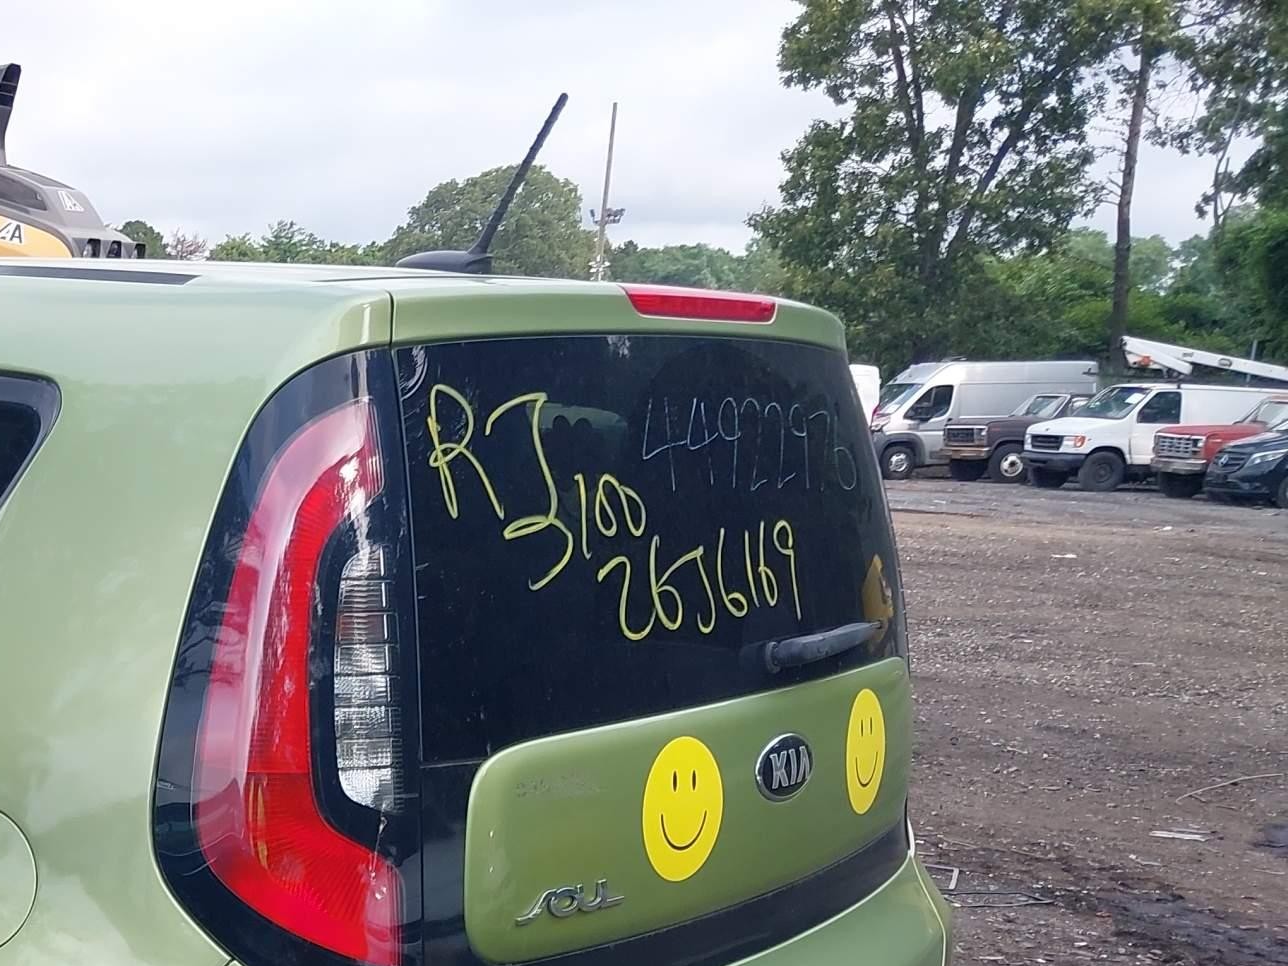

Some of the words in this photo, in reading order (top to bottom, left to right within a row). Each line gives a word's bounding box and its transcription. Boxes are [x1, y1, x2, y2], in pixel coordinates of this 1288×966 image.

[596, 518, 803, 642] 26J6169
[769, 744, 810, 790] KIA
[514, 878, 625, 926] SOUL
